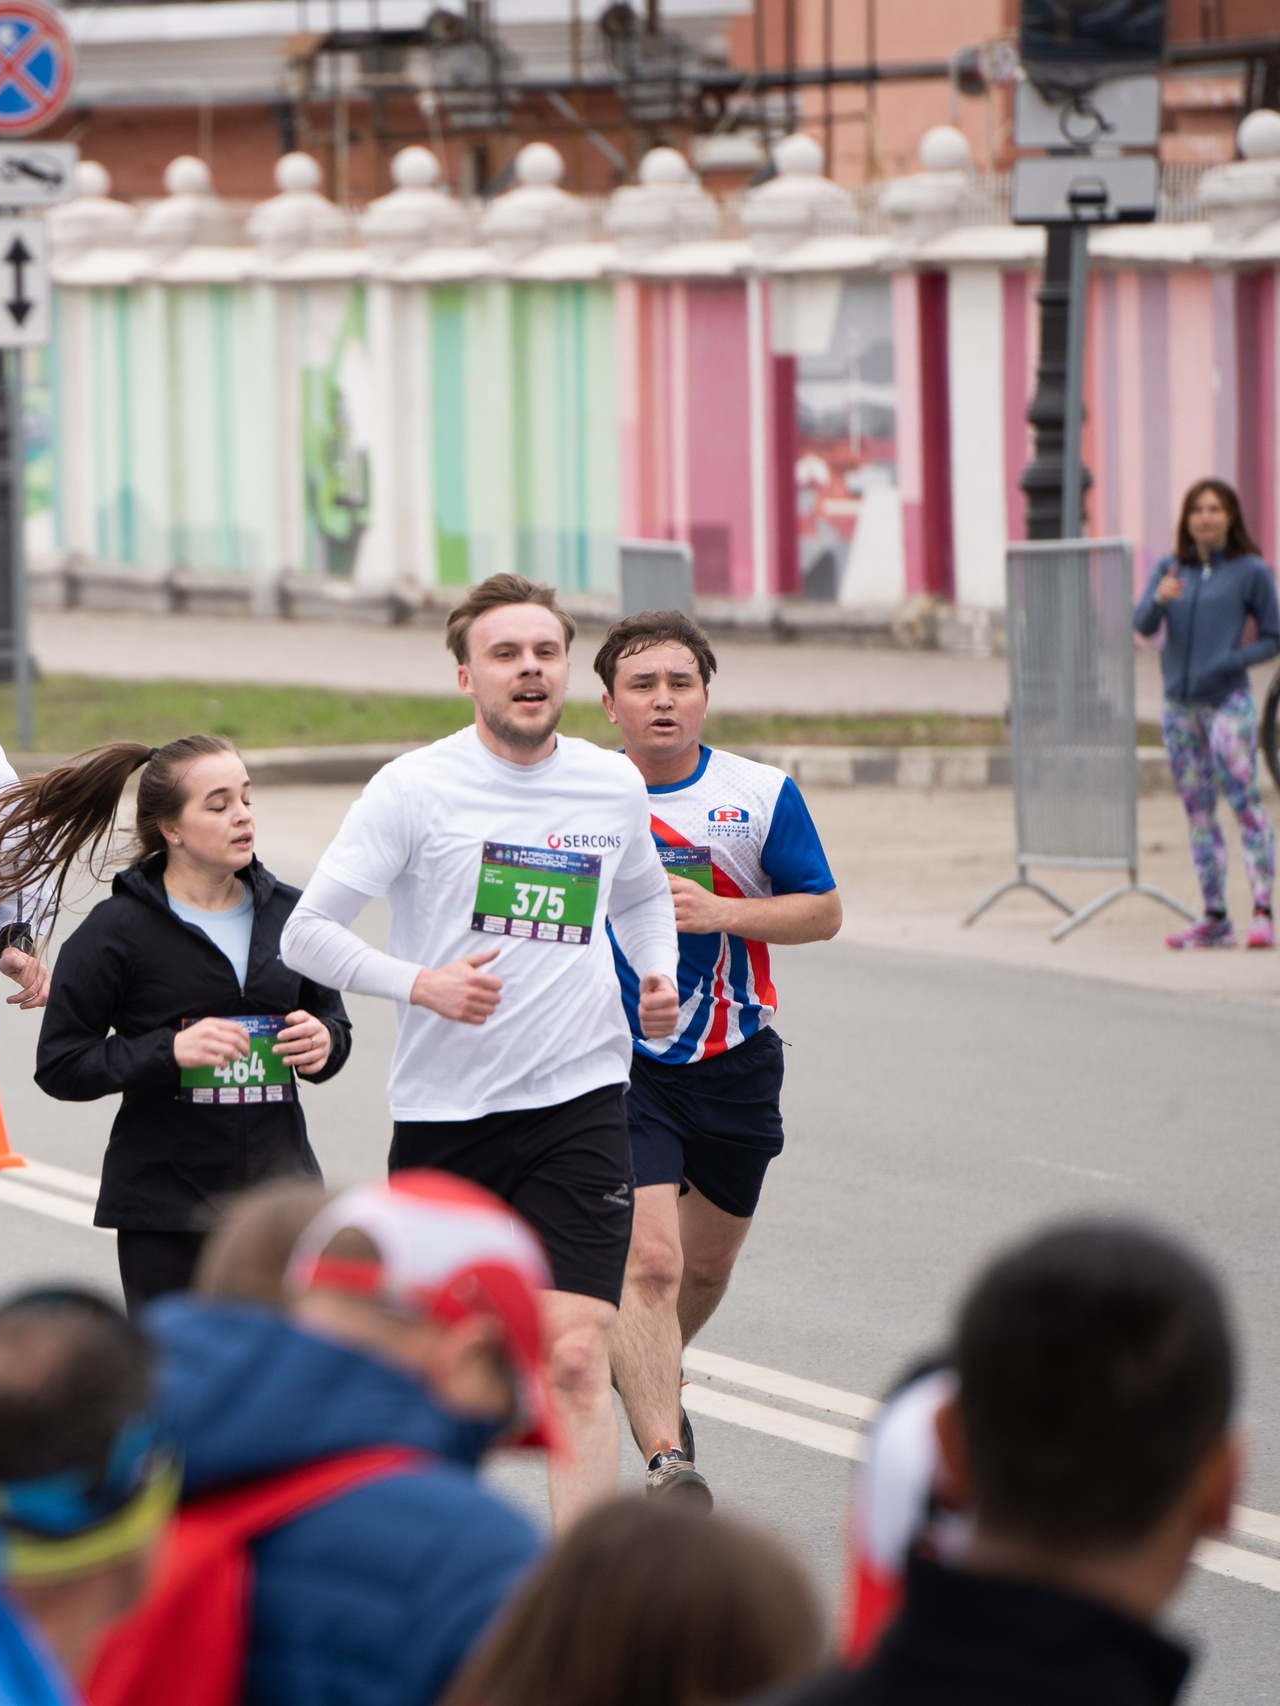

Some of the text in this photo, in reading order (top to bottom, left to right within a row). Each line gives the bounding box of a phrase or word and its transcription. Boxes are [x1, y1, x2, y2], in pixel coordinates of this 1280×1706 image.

[563, 834, 621, 849] SERCONS
[527, 851, 569, 862] ПРОСТО
[510, 882, 566, 921] 375
[213, 1051, 266, 1084] 464
